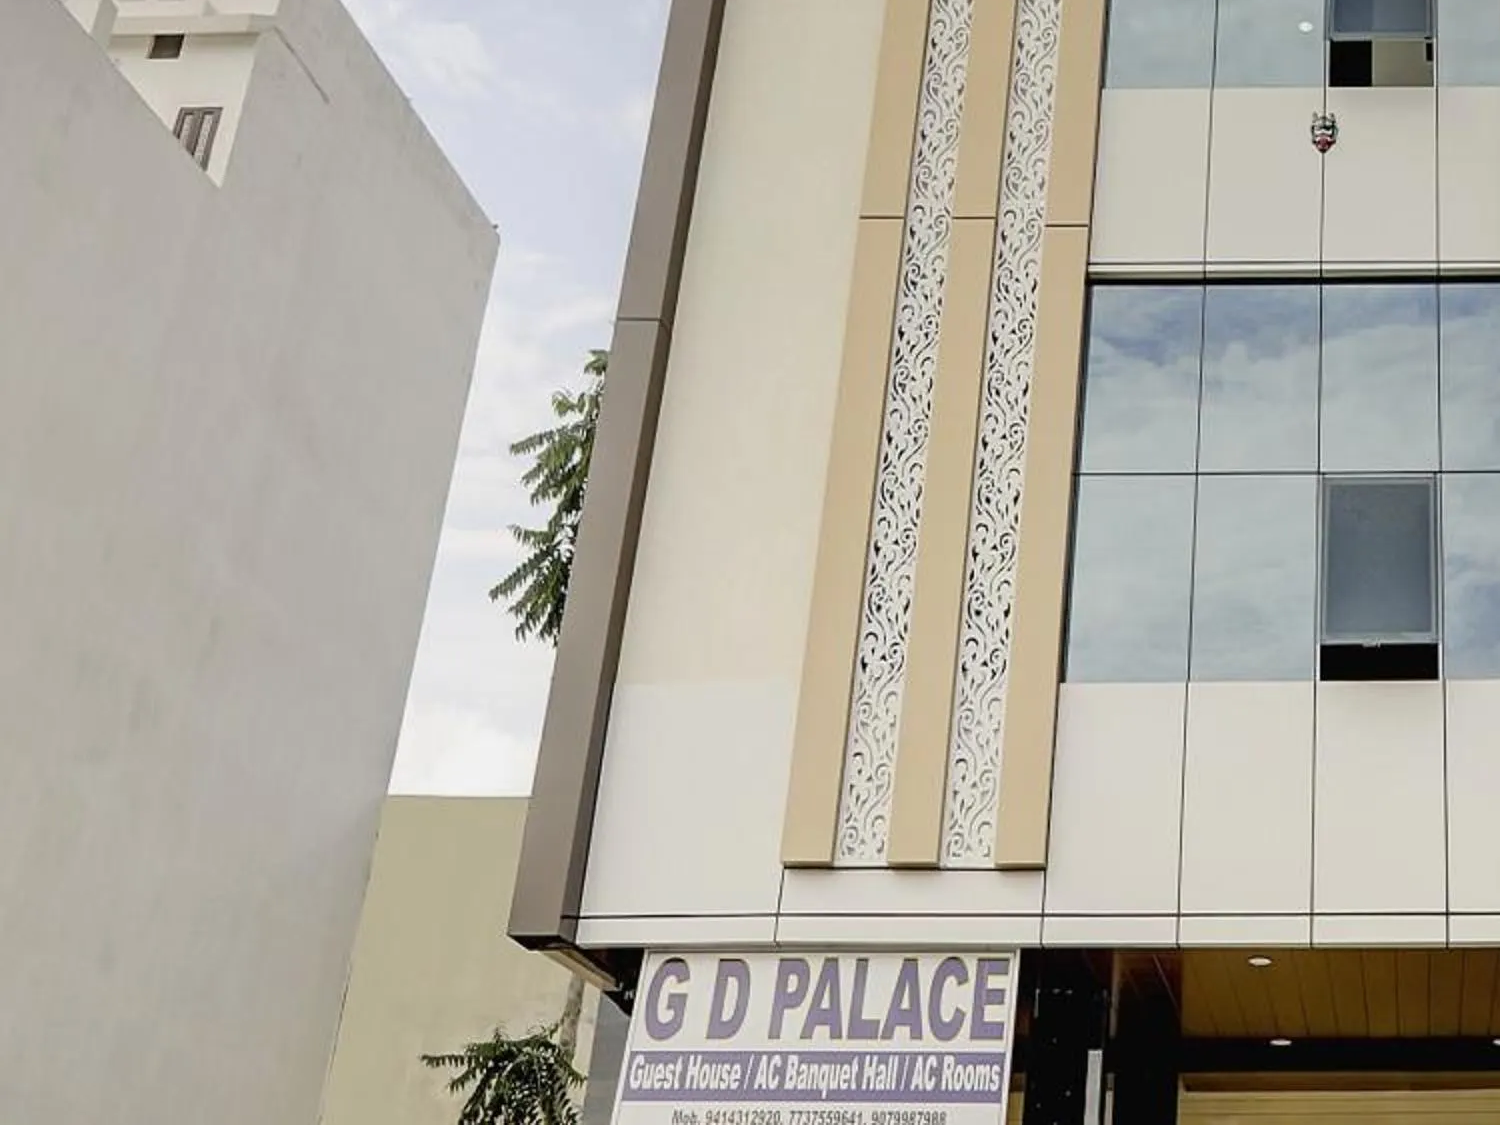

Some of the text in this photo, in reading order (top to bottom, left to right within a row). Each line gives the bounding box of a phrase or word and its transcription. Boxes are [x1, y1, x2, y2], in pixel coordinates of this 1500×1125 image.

[645, 957, 1010, 1041] G D PALACE
[629, 1055, 683, 1090] Guest
[686, 1055, 741, 1090] House
[755, 1055, 781, 1090] AC
[784, 1055, 861, 1097] Banquet
[862, 1055, 899, 1091] Hall
[910, 1055, 938, 1091] AC
[942, 1055, 1001, 1091] Rooms
